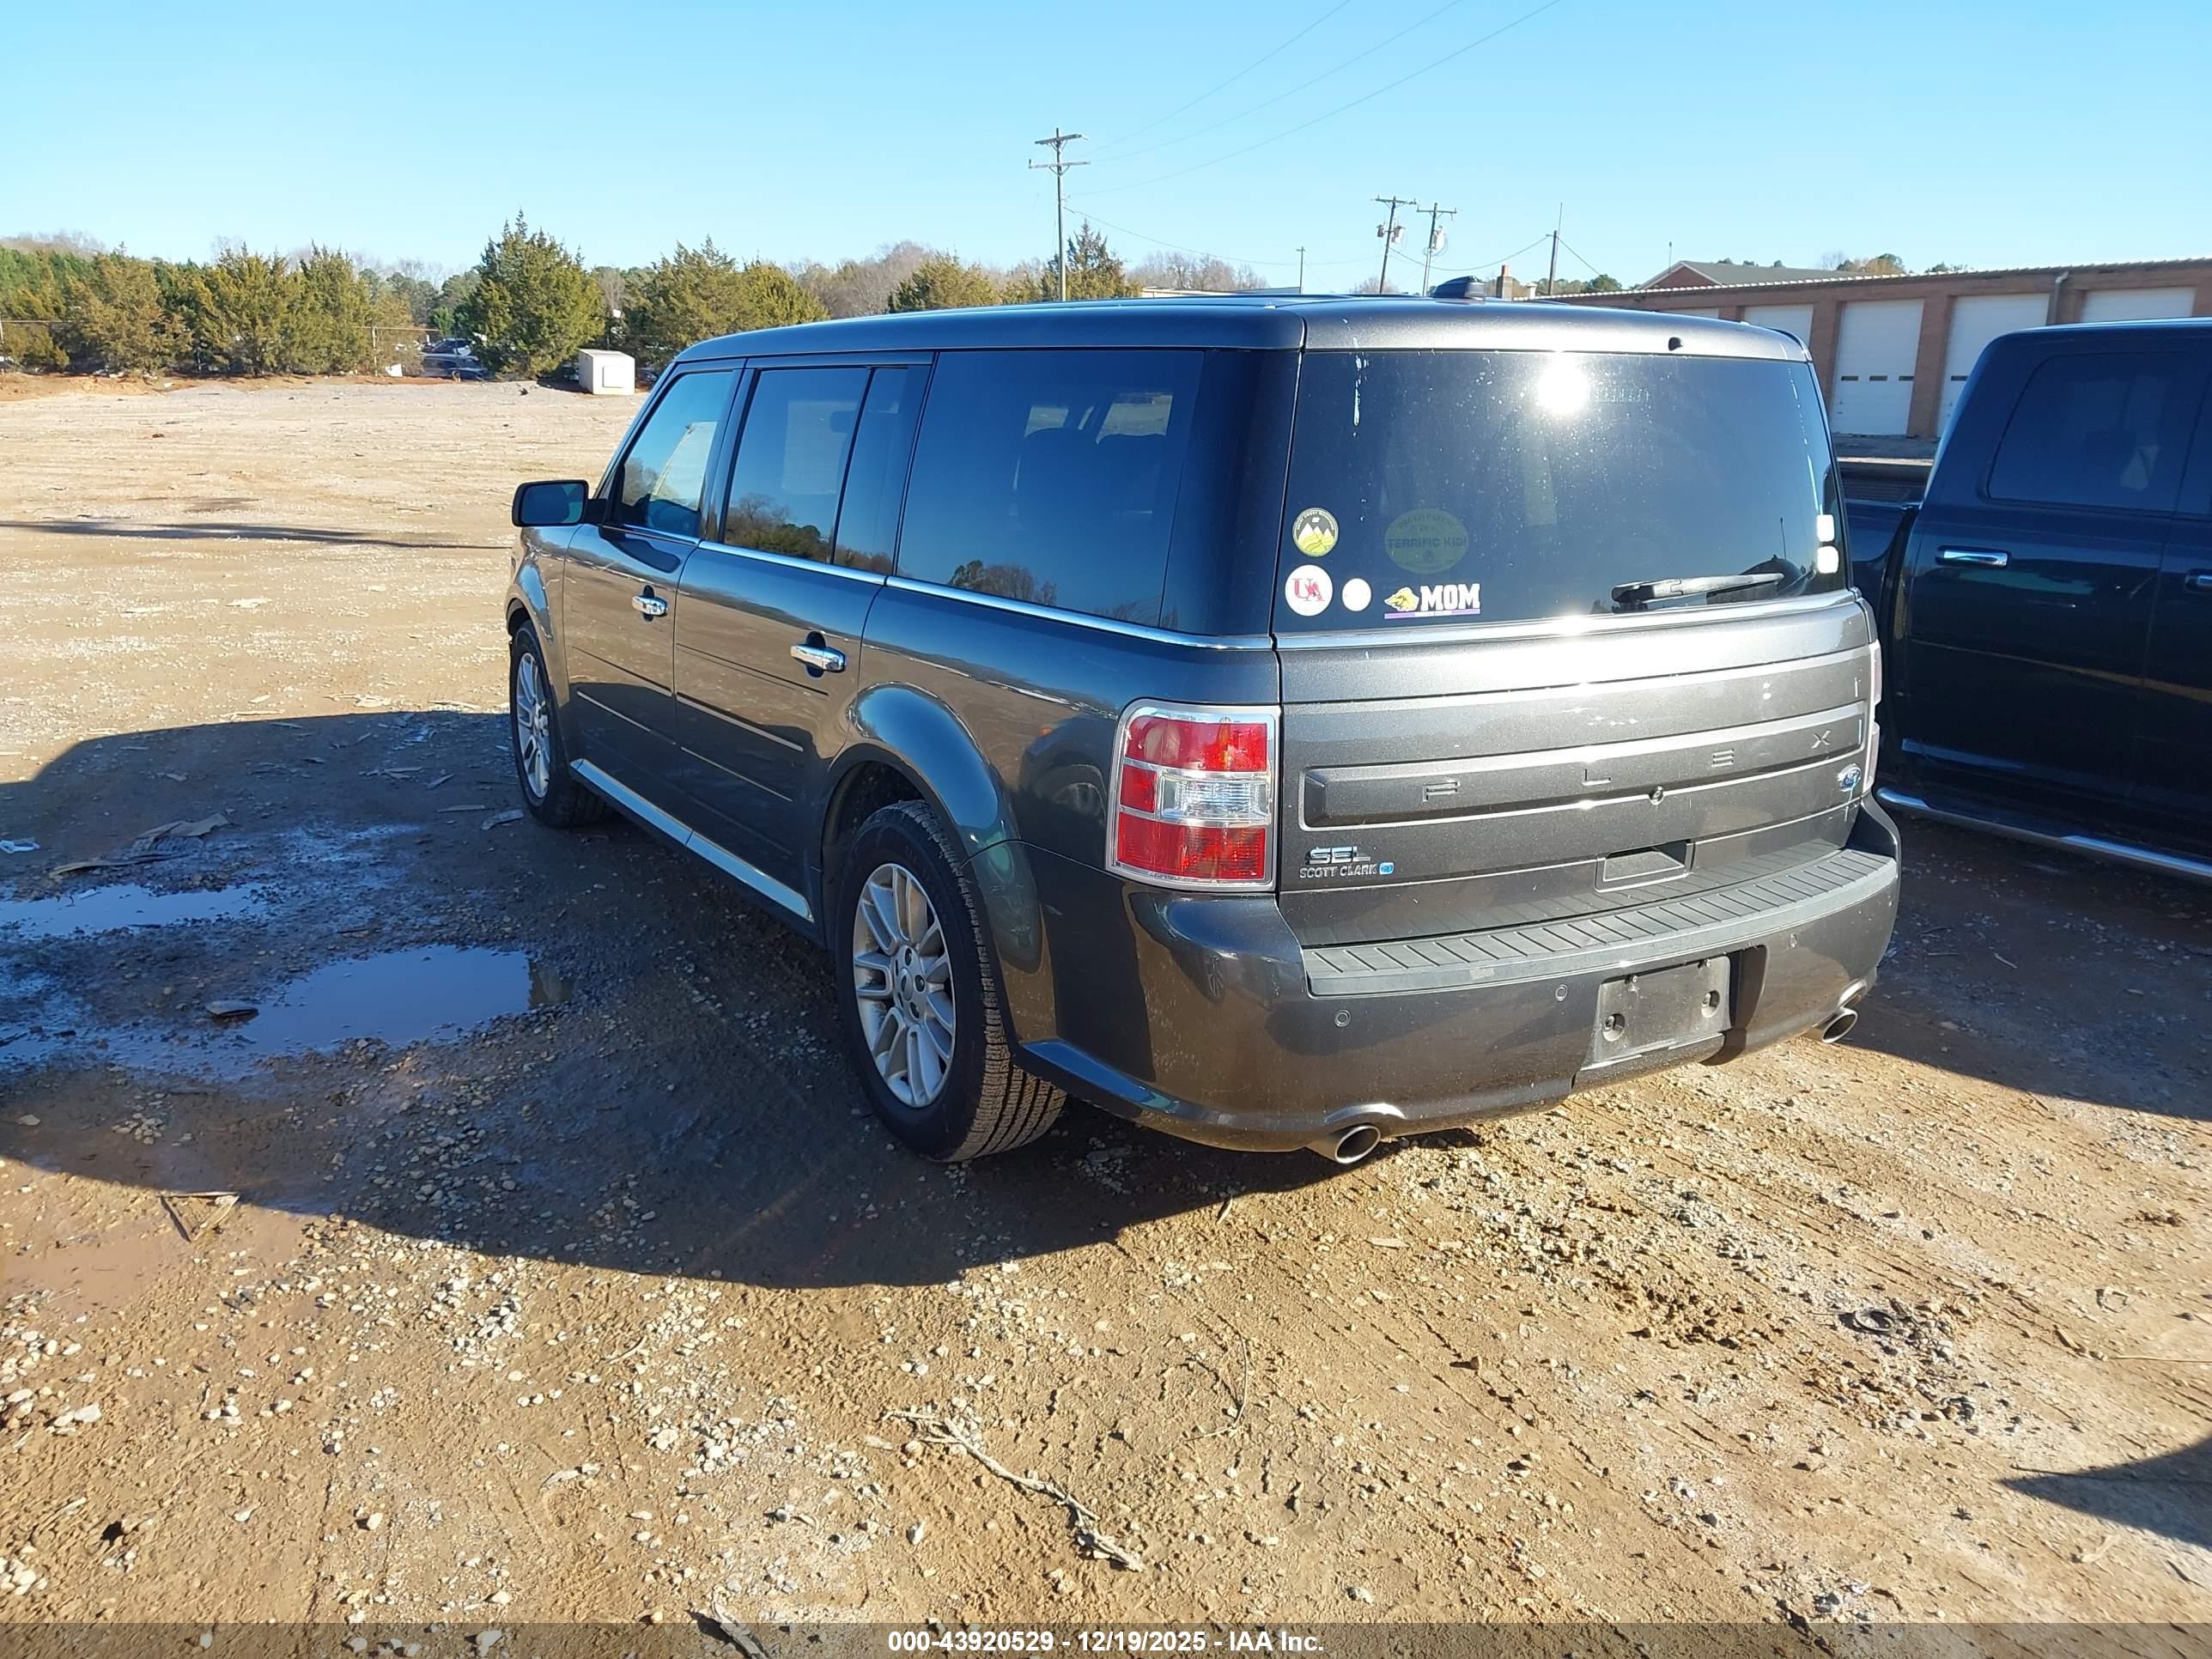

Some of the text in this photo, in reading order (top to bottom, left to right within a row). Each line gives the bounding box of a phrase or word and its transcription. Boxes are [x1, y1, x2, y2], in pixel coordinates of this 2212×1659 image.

[1387, 537, 1441, 549] TERRIFIC
[1419, 583, 1480, 611] MOM
[1308, 846, 1371, 865] SEL
[1299, 866, 1338, 878] SCOTT
[1340, 863, 1377, 876] CLARK
